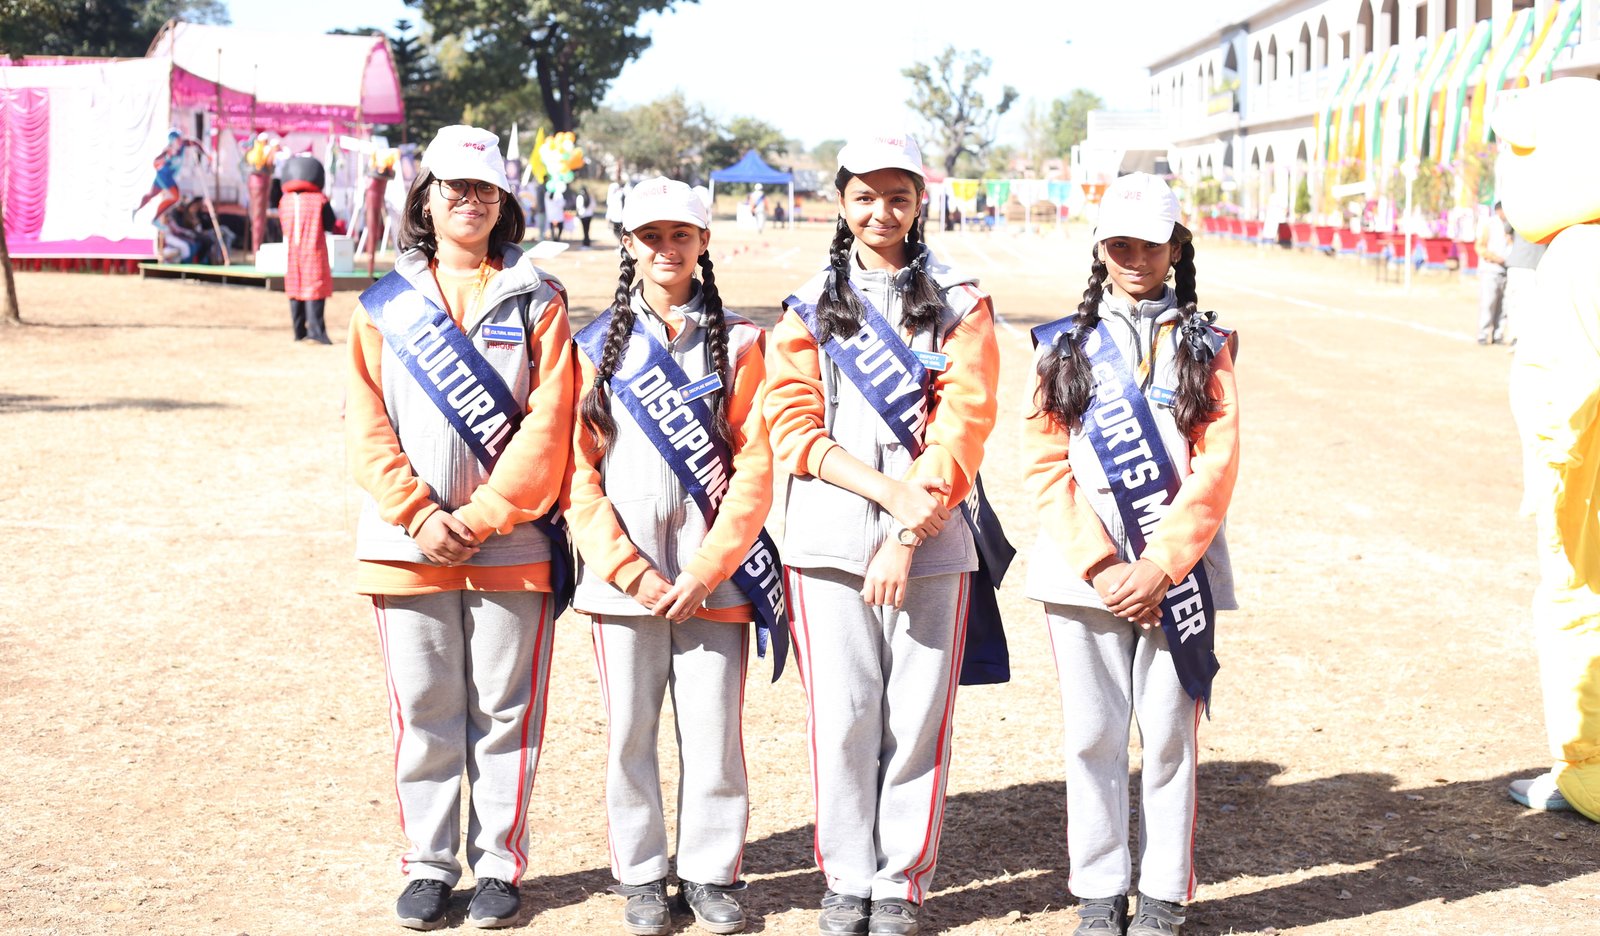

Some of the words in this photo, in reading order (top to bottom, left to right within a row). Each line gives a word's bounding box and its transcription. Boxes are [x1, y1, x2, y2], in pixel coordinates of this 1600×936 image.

[406, 323, 512, 457] CULTURAL
[831, 319, 921, 405] PUTY
[1091, 361, 1160, 490] SPORTS
[629, 365, 729, 511] DISCIPLINE
[740, 538, 785, 625] ISTER
